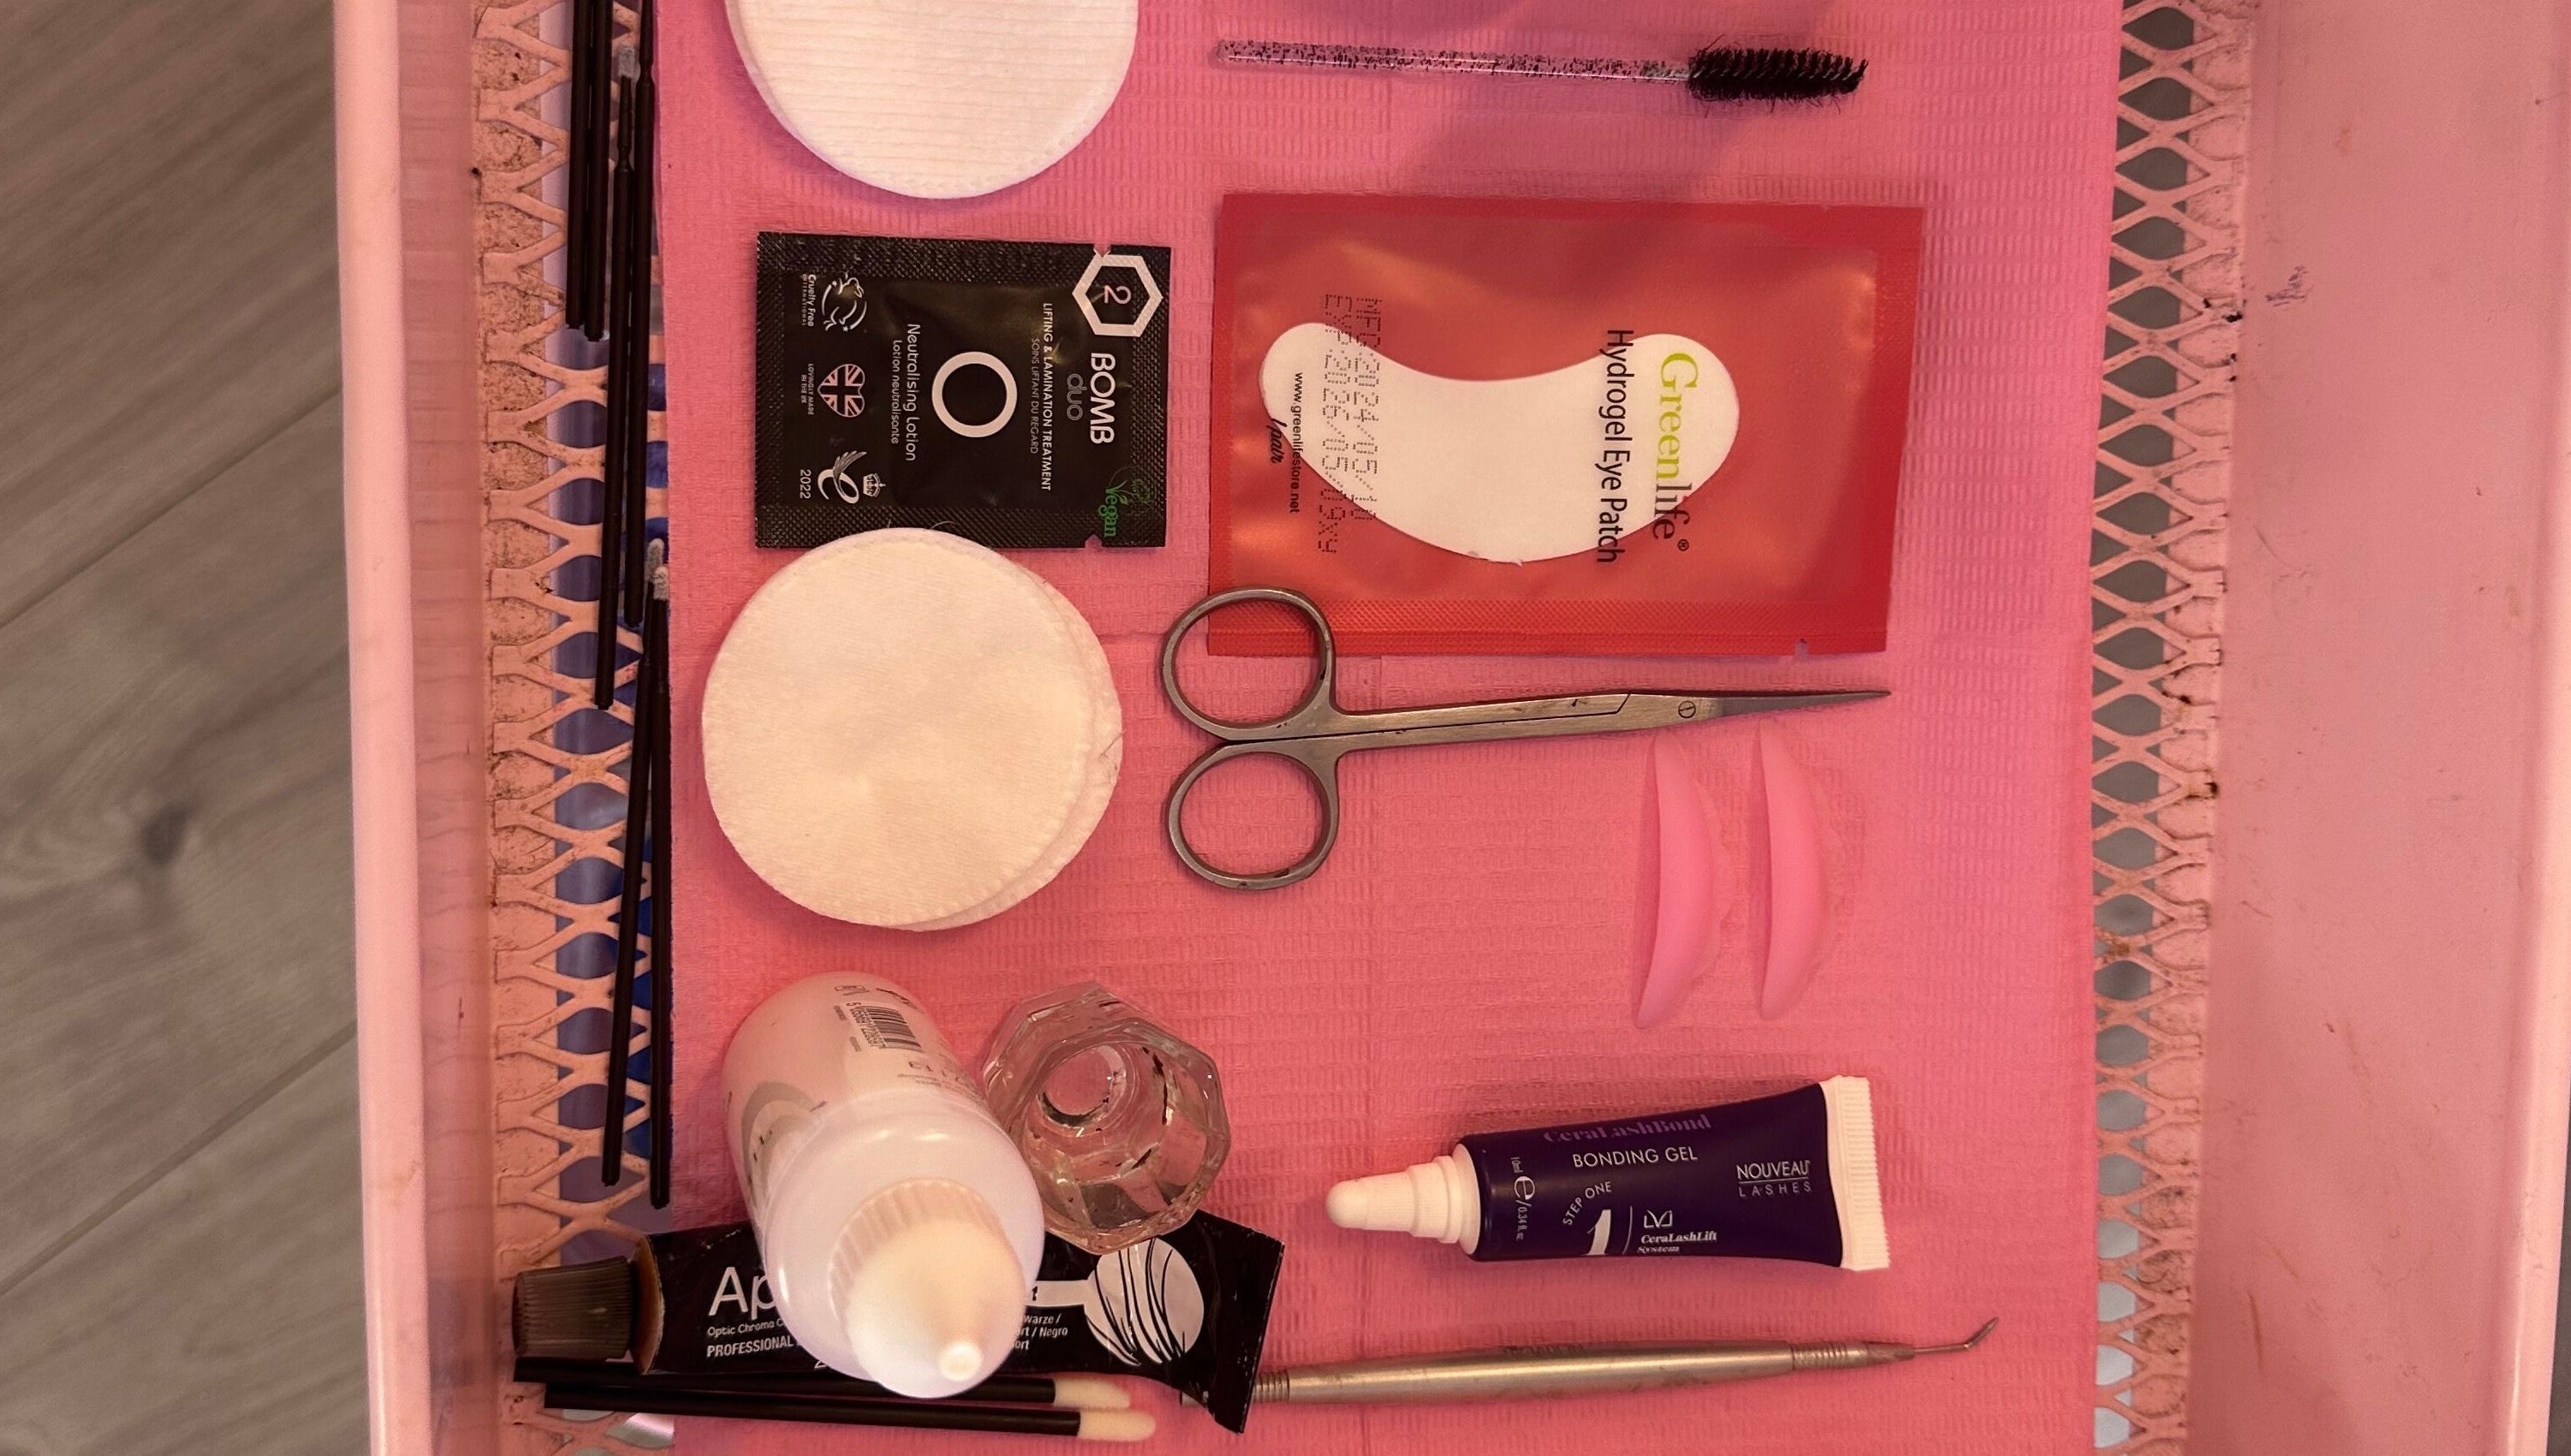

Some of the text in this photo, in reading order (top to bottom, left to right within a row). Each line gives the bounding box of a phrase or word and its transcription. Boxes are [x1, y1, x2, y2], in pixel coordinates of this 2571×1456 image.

[806, 274, 816, 305] Cruelty
[1104, 284, 1132, 304] 2
[1043, 303, 1053, 342] LIFTING
[891, 340, 902, 443] Lotion neutralisante
[903, 324, 921, 461] Neutralising Lotion
[1030, 338, 1040, 454] SOINS LIFTANT DU REGARD
[1042, 357, 1053, 426] LAMINATION
[1067, 373, 1087, 421] duo
[1091, 353, 1116, 443] BOMB
[1041, 431, 1052, 490] TREATMENT
[1266, 425, 1285, 463] pair
[1289, 373, 1304, 513] www.greenlifestore.net
[1595, 330, 1634, 563] Hydrogel Eye Patch
[800, 469, 811, 498] 2022
[1098, 479, 1127, 538] Vegan
[1544, 1114, 1711, 1143] CeraLashBond
[1573, 1146, 1698, 1168] BONDING GEL
[1736, 1160, 1811, 1180] NOUVEAU
[1562, 1181, 1612, 1225] STEP ONE
[1739, 1181, 1812, 1197] LASHES
[1581, 1209, 1610, 1255] 1
[1641, 1231, 1717, 1244] CeraLashLift
[708, 1267, 777, 1320] Ap
[706, 1335, 794, 1358] PROFESSIONAL
[707, 1327, 735, 1338] Optic
[1039, 1327, 1068, 1337] Negro
